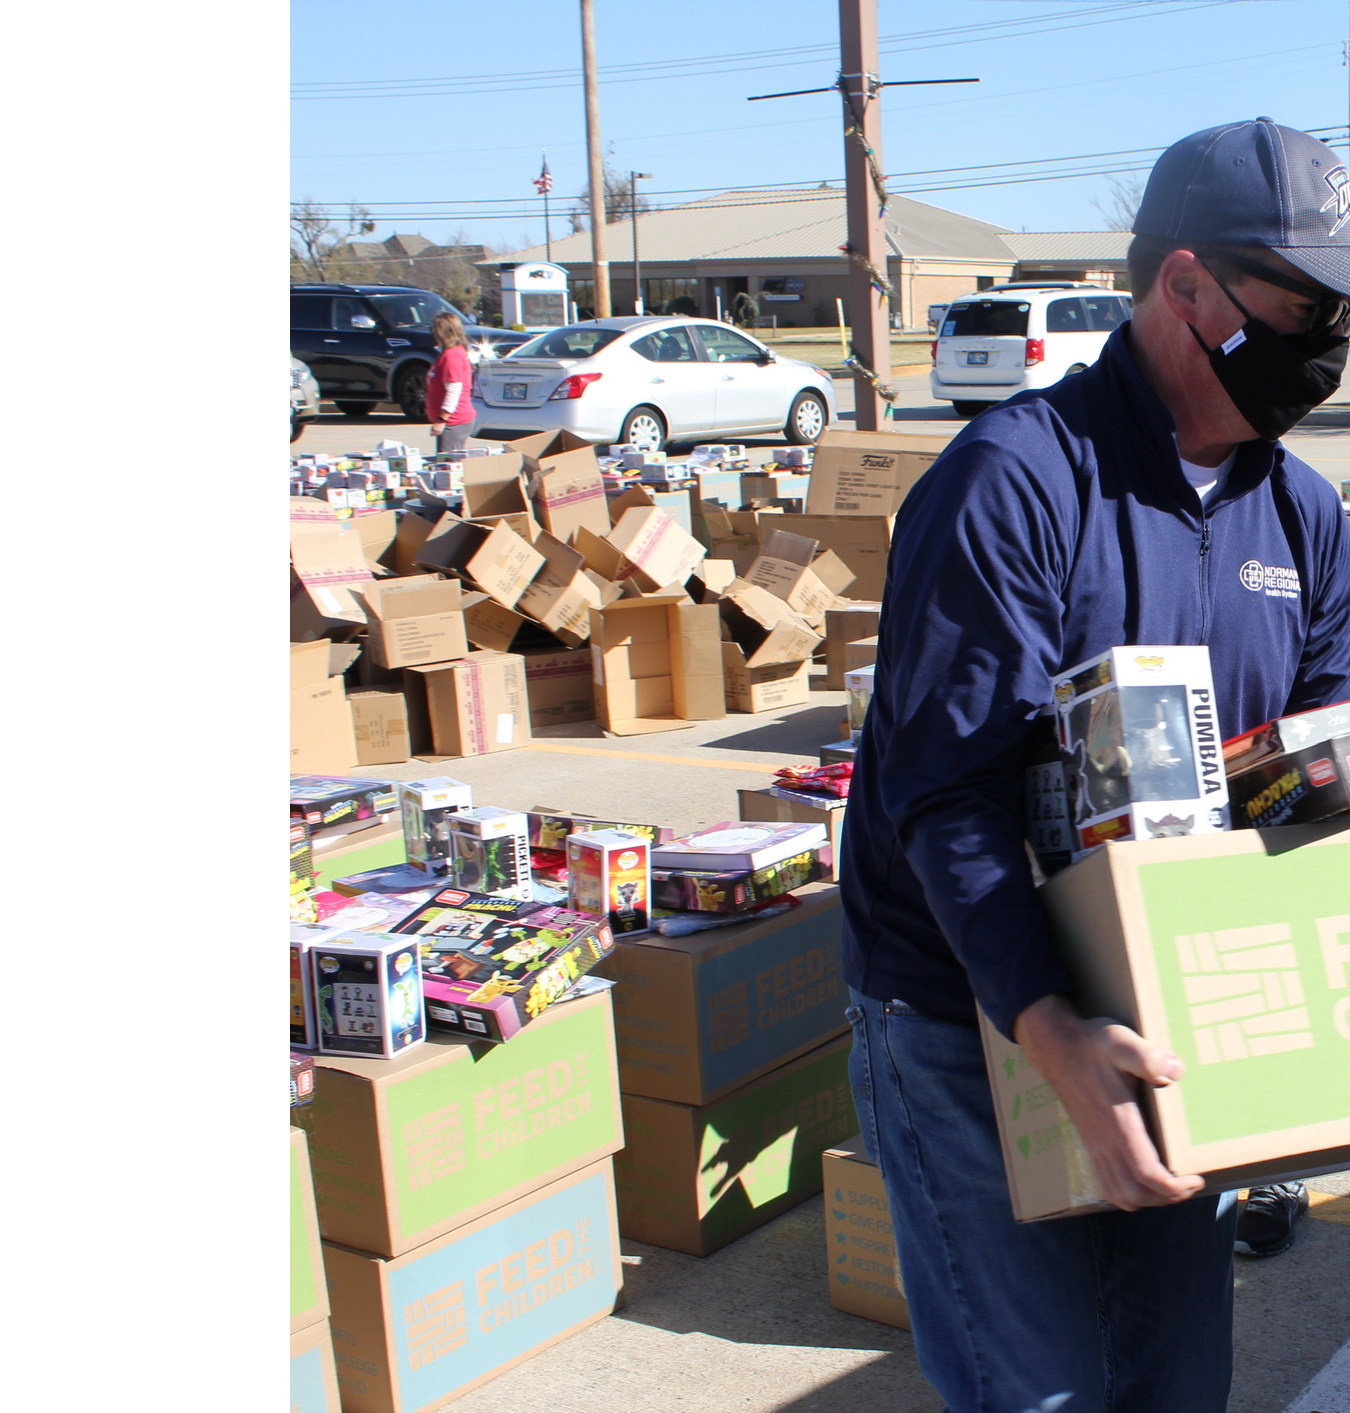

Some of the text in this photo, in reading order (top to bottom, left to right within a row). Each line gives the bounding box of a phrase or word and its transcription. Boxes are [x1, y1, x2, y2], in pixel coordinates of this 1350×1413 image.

[1264, 566, 1299, 580] NORMAN
[1191, 688, 1222, 796] PUMBAA
[517, 834, 529, 882] PICKETT
[755, 947, 823, 1006] FEED
[574, 1051, 593, 1088] THE
[472, 1060, 573, 1133] FEED
[576, 1217, 591, 1256] THE
[475, 1228, 574, 1308] FEED
